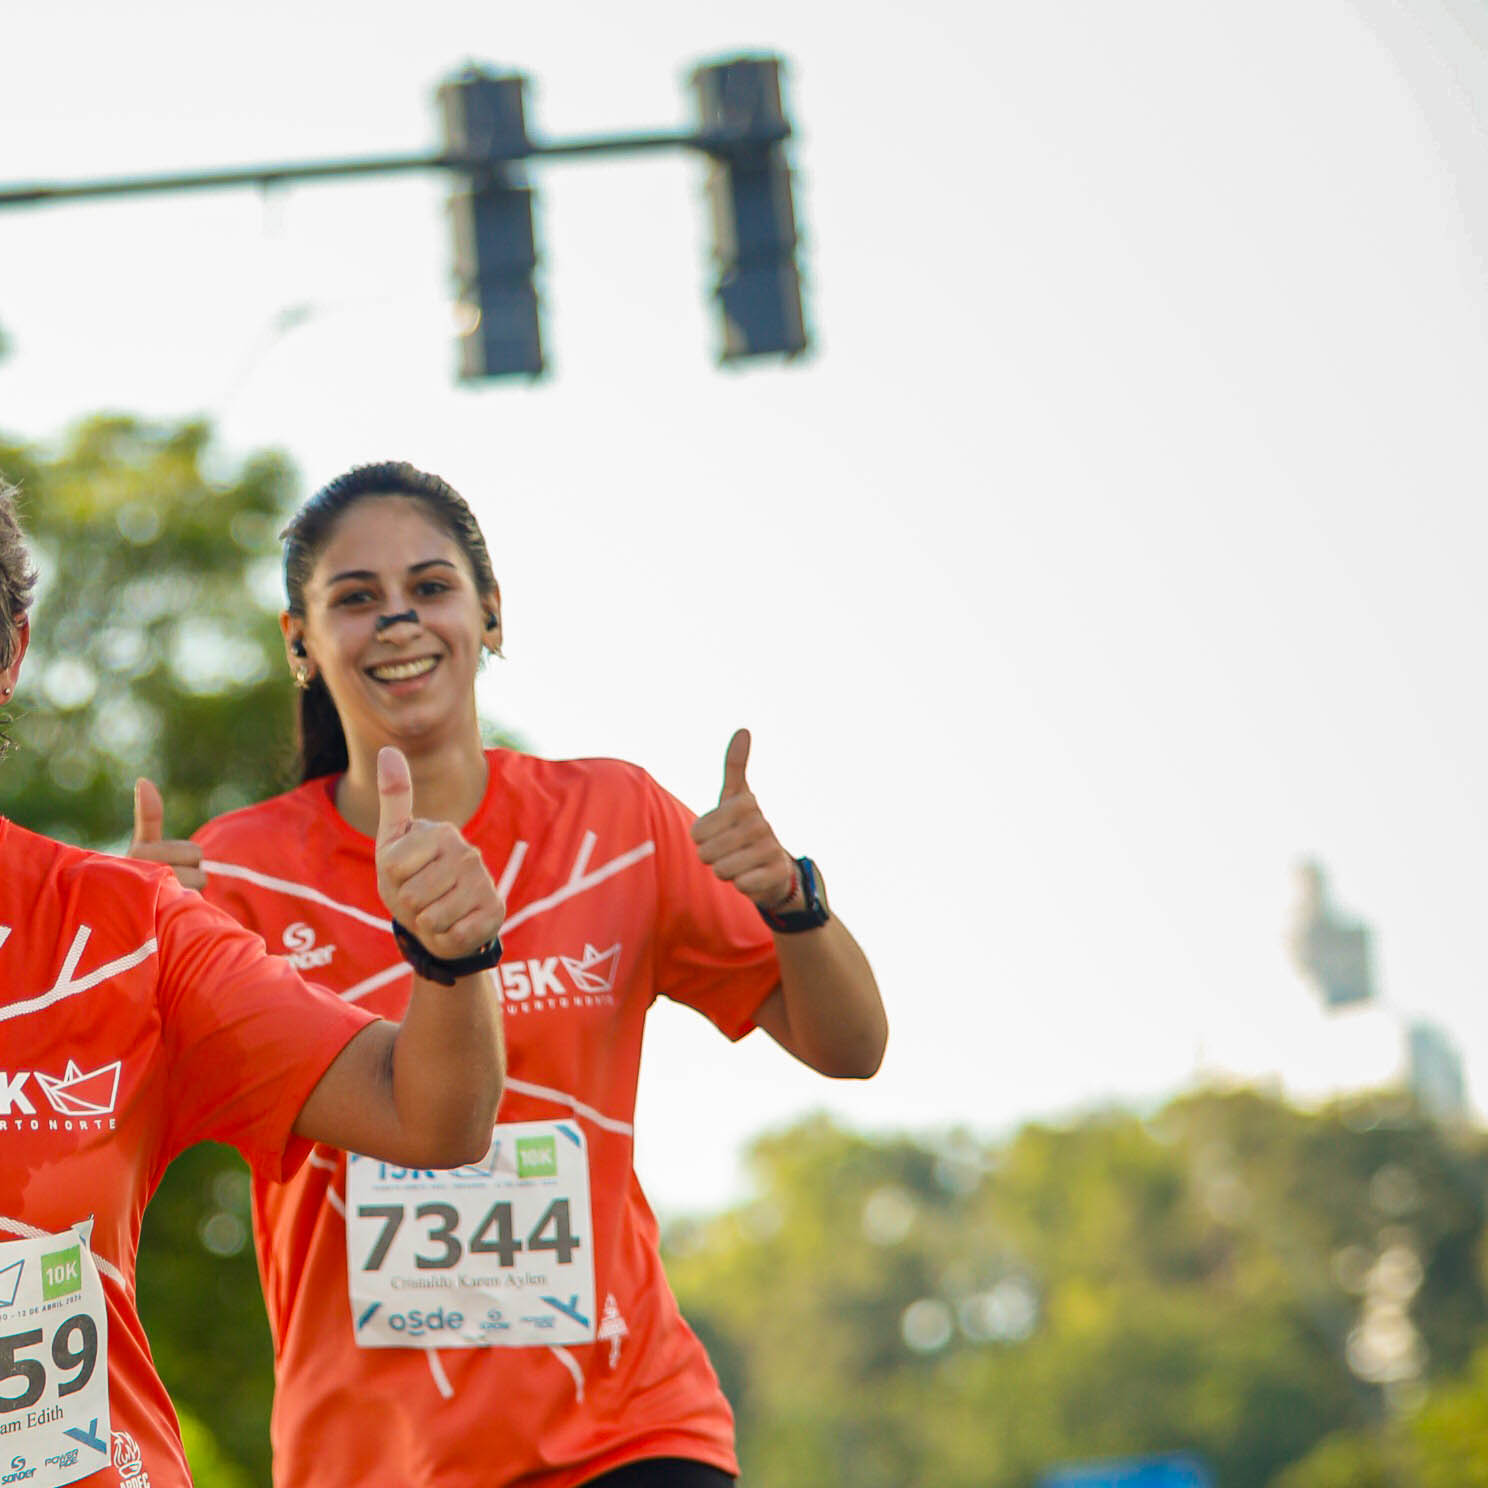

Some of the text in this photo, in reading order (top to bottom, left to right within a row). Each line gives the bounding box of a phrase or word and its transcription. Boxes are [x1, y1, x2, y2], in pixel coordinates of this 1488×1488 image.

[48, 1118, 117, 1131] NORTE
[357, 1197, 580, 1271] 7344
[45, 1261, 79, 1286] 10K
[388, 1305, 465, 1336] osde
[27, 1404, 64, 1428] Edith
